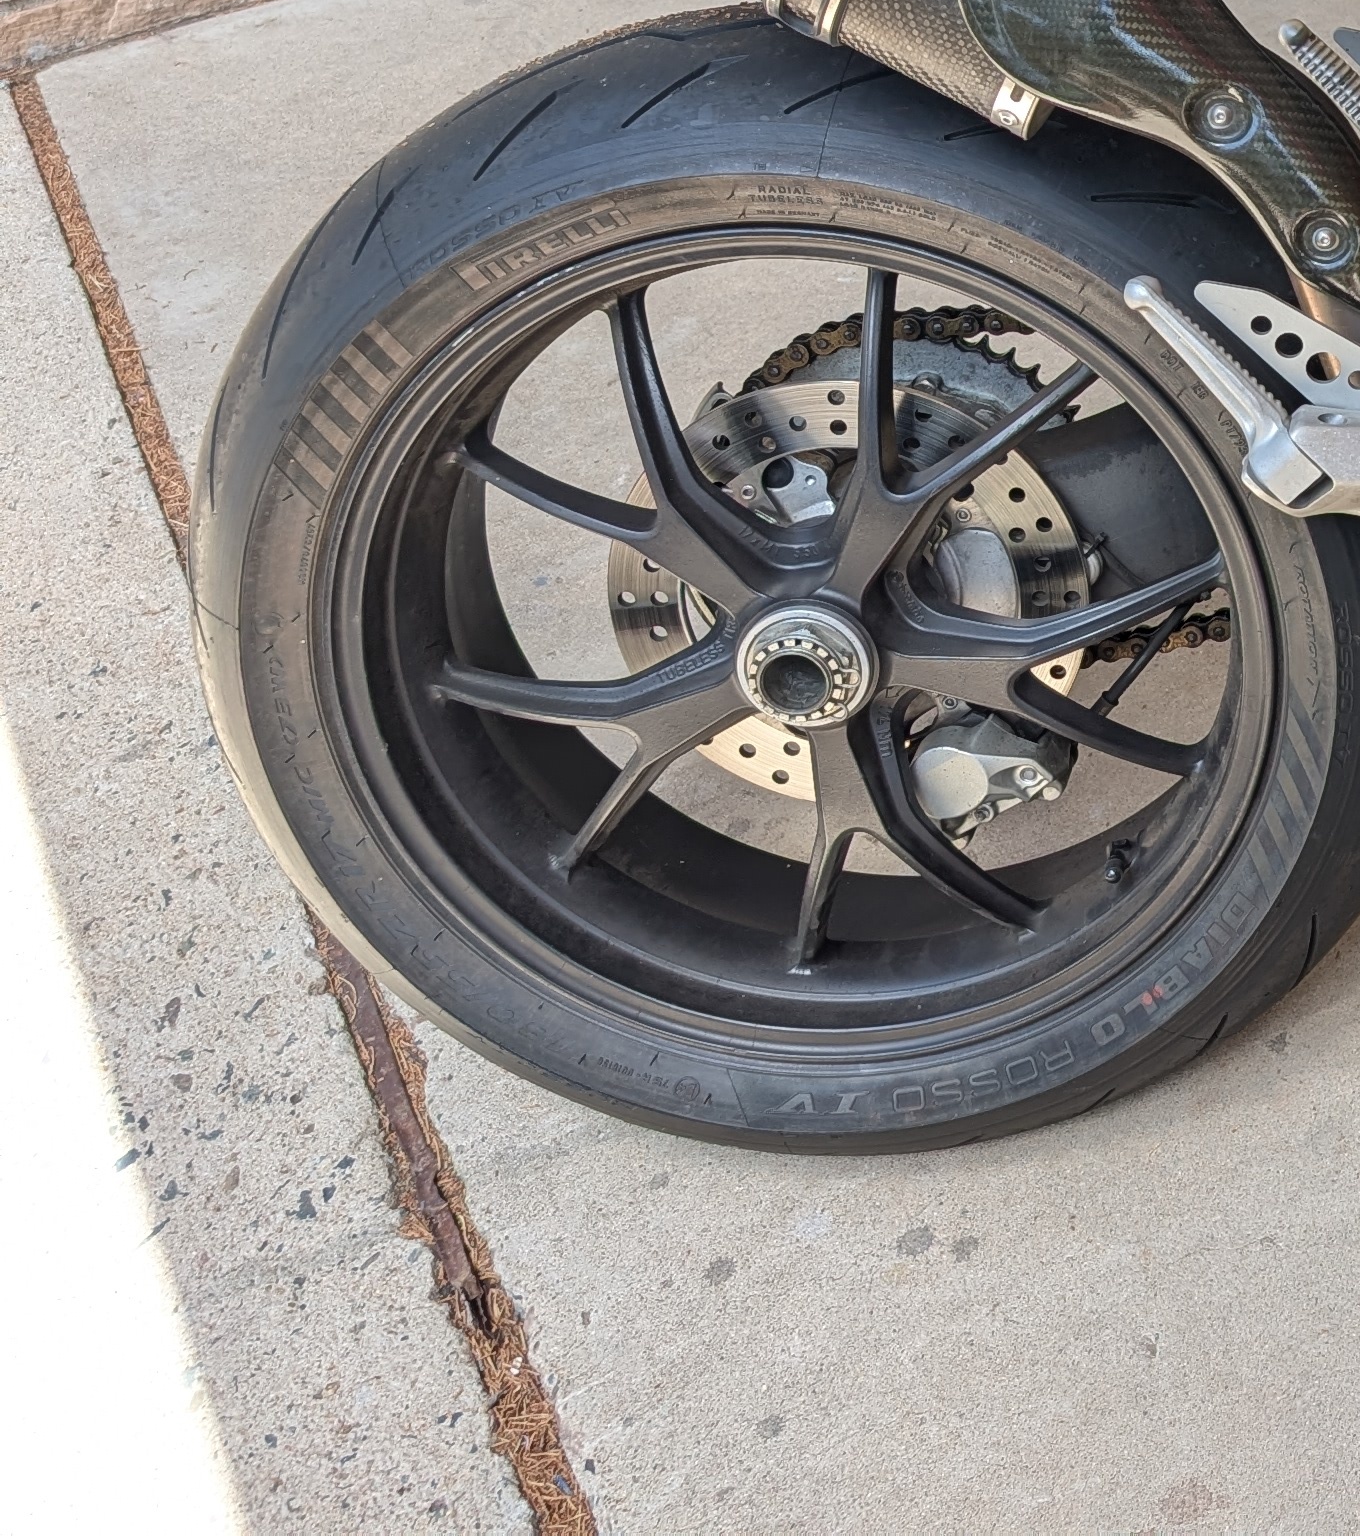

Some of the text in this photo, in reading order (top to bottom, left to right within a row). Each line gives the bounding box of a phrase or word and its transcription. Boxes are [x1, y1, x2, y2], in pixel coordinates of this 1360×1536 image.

[748, 194, 824, 206] TUBELESS
[757, 184, 812, 196] RADIAL
[449, 196, 632, 292] PIRELLI
[1160, 349, 1185, 371] DOT
[655, 637, 726, 684] TUBELESS
[763, 891, 1261, 1117] DIABLO ROSSO IV
